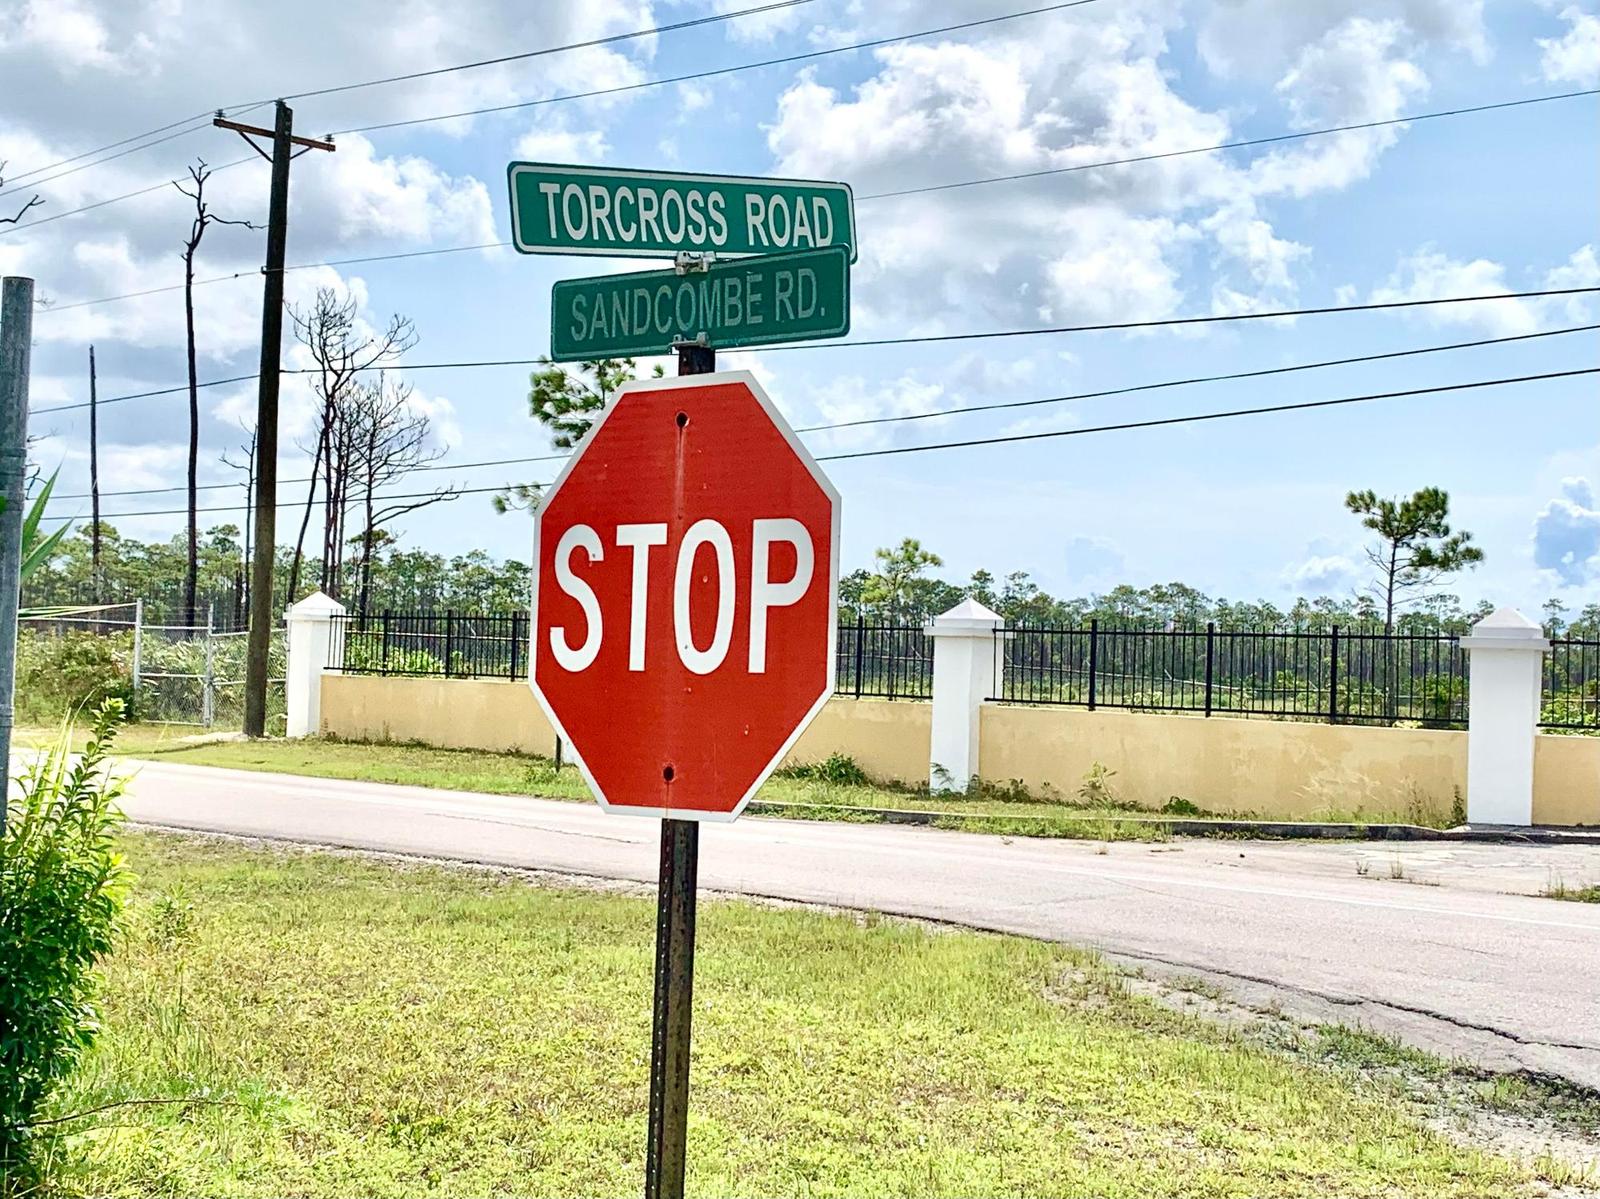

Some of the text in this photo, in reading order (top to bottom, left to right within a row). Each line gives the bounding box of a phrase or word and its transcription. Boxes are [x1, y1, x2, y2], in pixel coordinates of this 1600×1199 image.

[539, 182, 834, 248] TORCROSS ROAD
[570, 267, 826, 342] SANDCOMBE RD.
[549, 517, 815, 676] STOP
